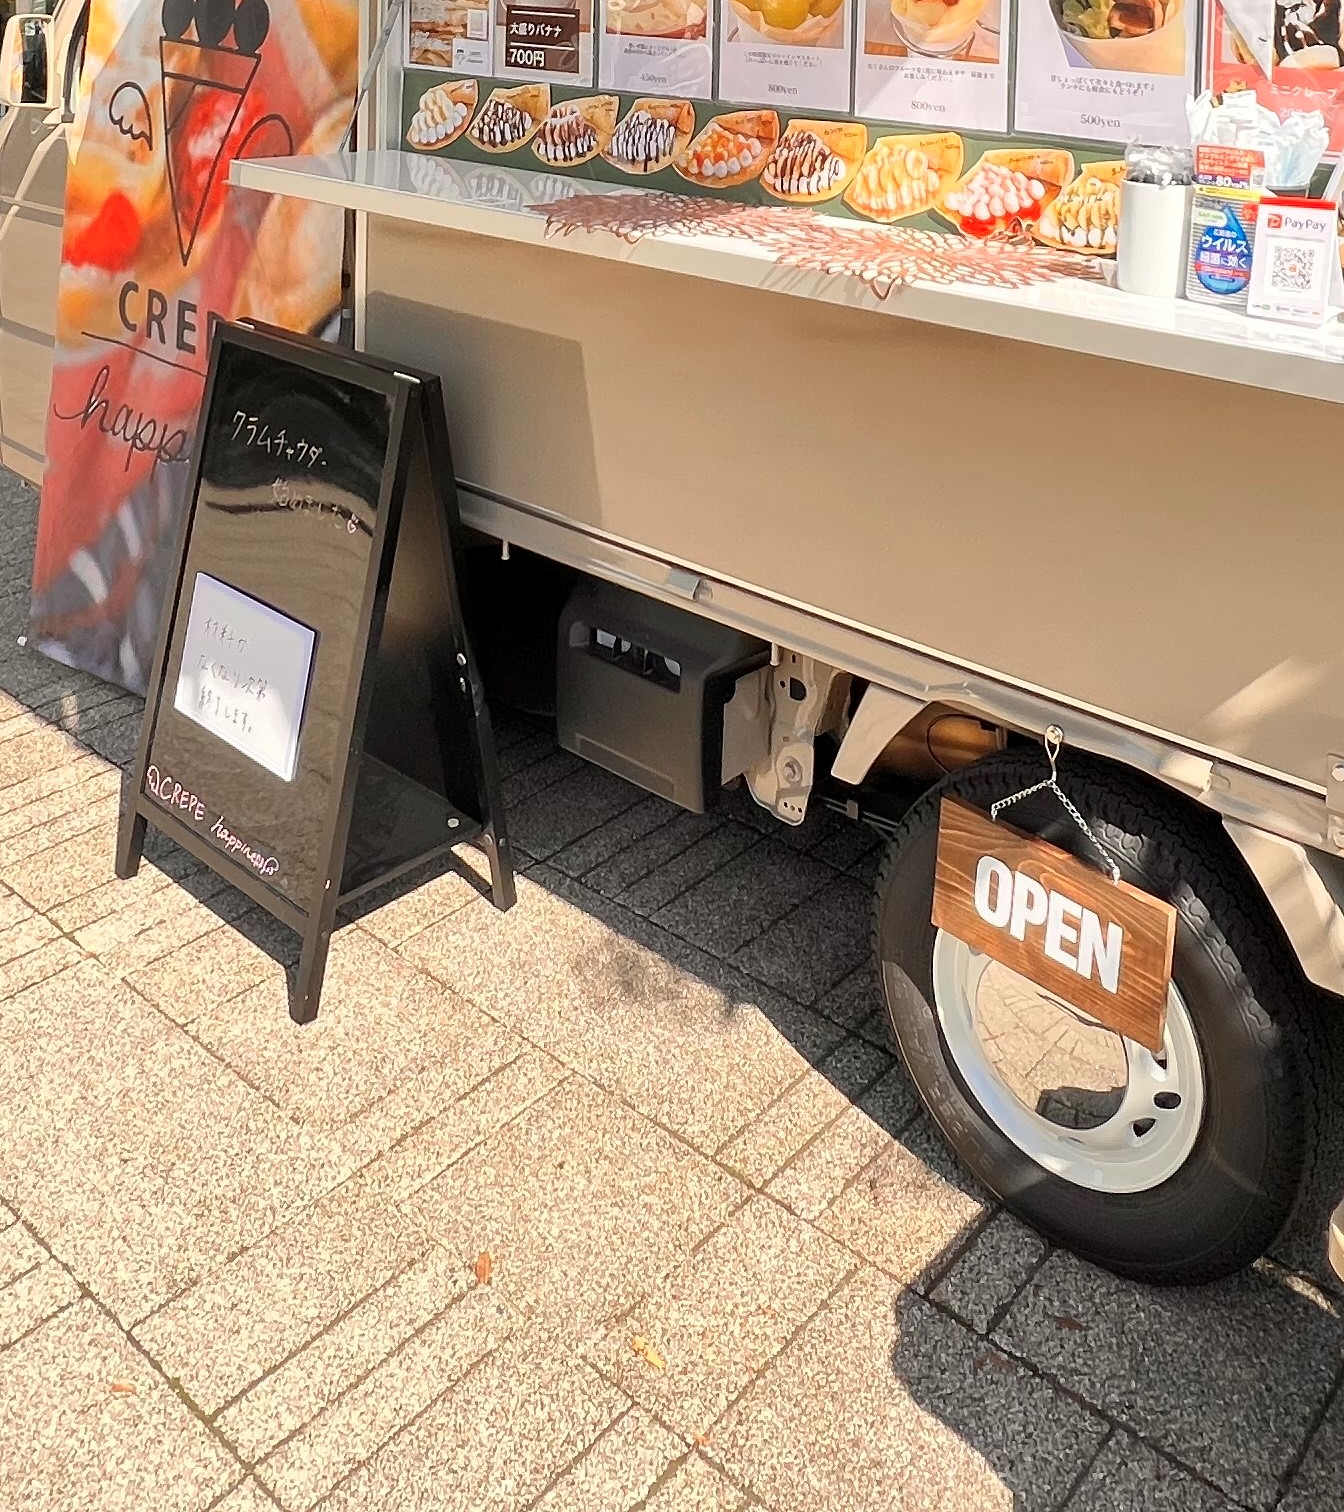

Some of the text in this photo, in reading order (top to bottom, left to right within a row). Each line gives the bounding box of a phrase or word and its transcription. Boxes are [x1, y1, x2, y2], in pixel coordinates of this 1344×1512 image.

[509, 21, 563, 38] 大盛りバナナ
[509, 48, 545, 68] 700円
[910, 99, 946, 112] 800yen
[1080, 114, 1121, 128] 500yen
[1284, 217, 1327, 233] PayPay
[1201, 235, 1249, 254] ウイルス
[159, 776, 206, 821] CREPE
[974, 855, 1124, 995] OPEN
